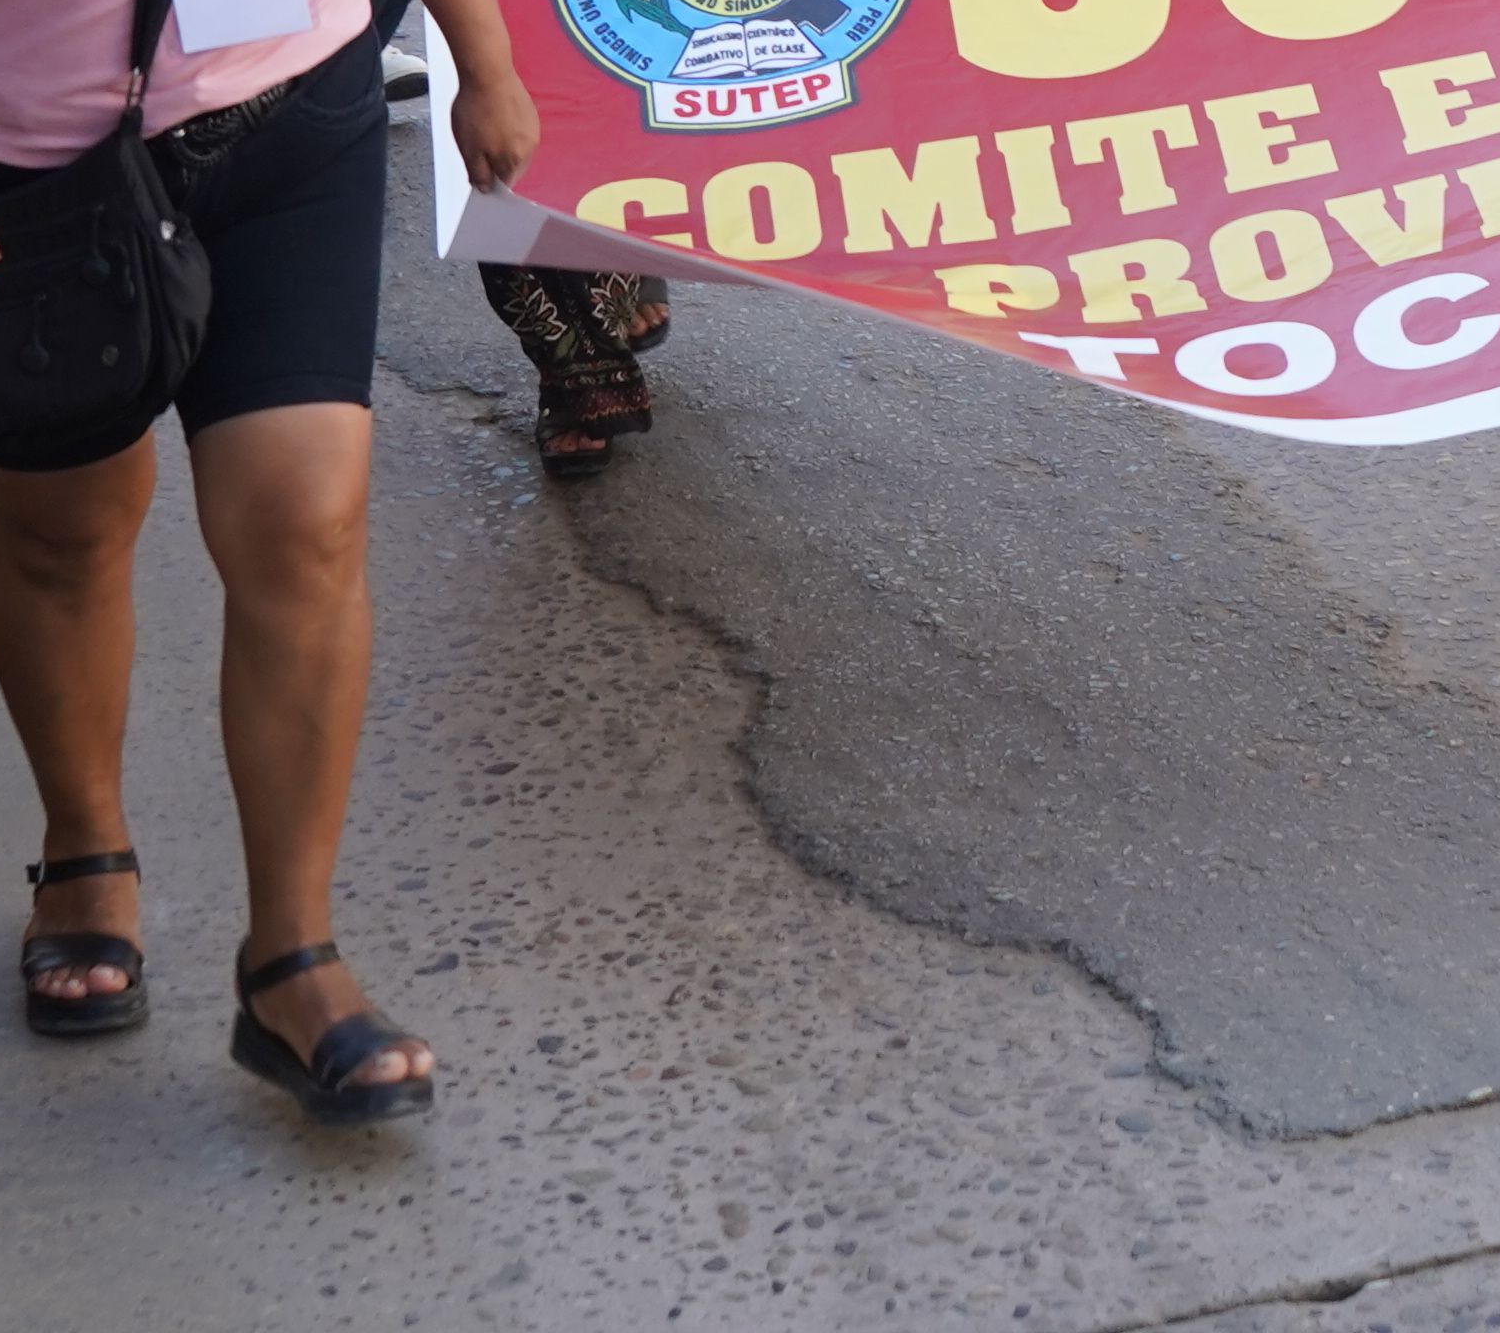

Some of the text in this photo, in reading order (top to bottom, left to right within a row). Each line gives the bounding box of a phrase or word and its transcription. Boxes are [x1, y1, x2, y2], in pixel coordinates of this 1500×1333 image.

[684, 43, 806, 68] COMBATIVO DE CLASE
[673, 73, 832, 118] SUTEP
[576, 82, 1339, 263] COMITE
